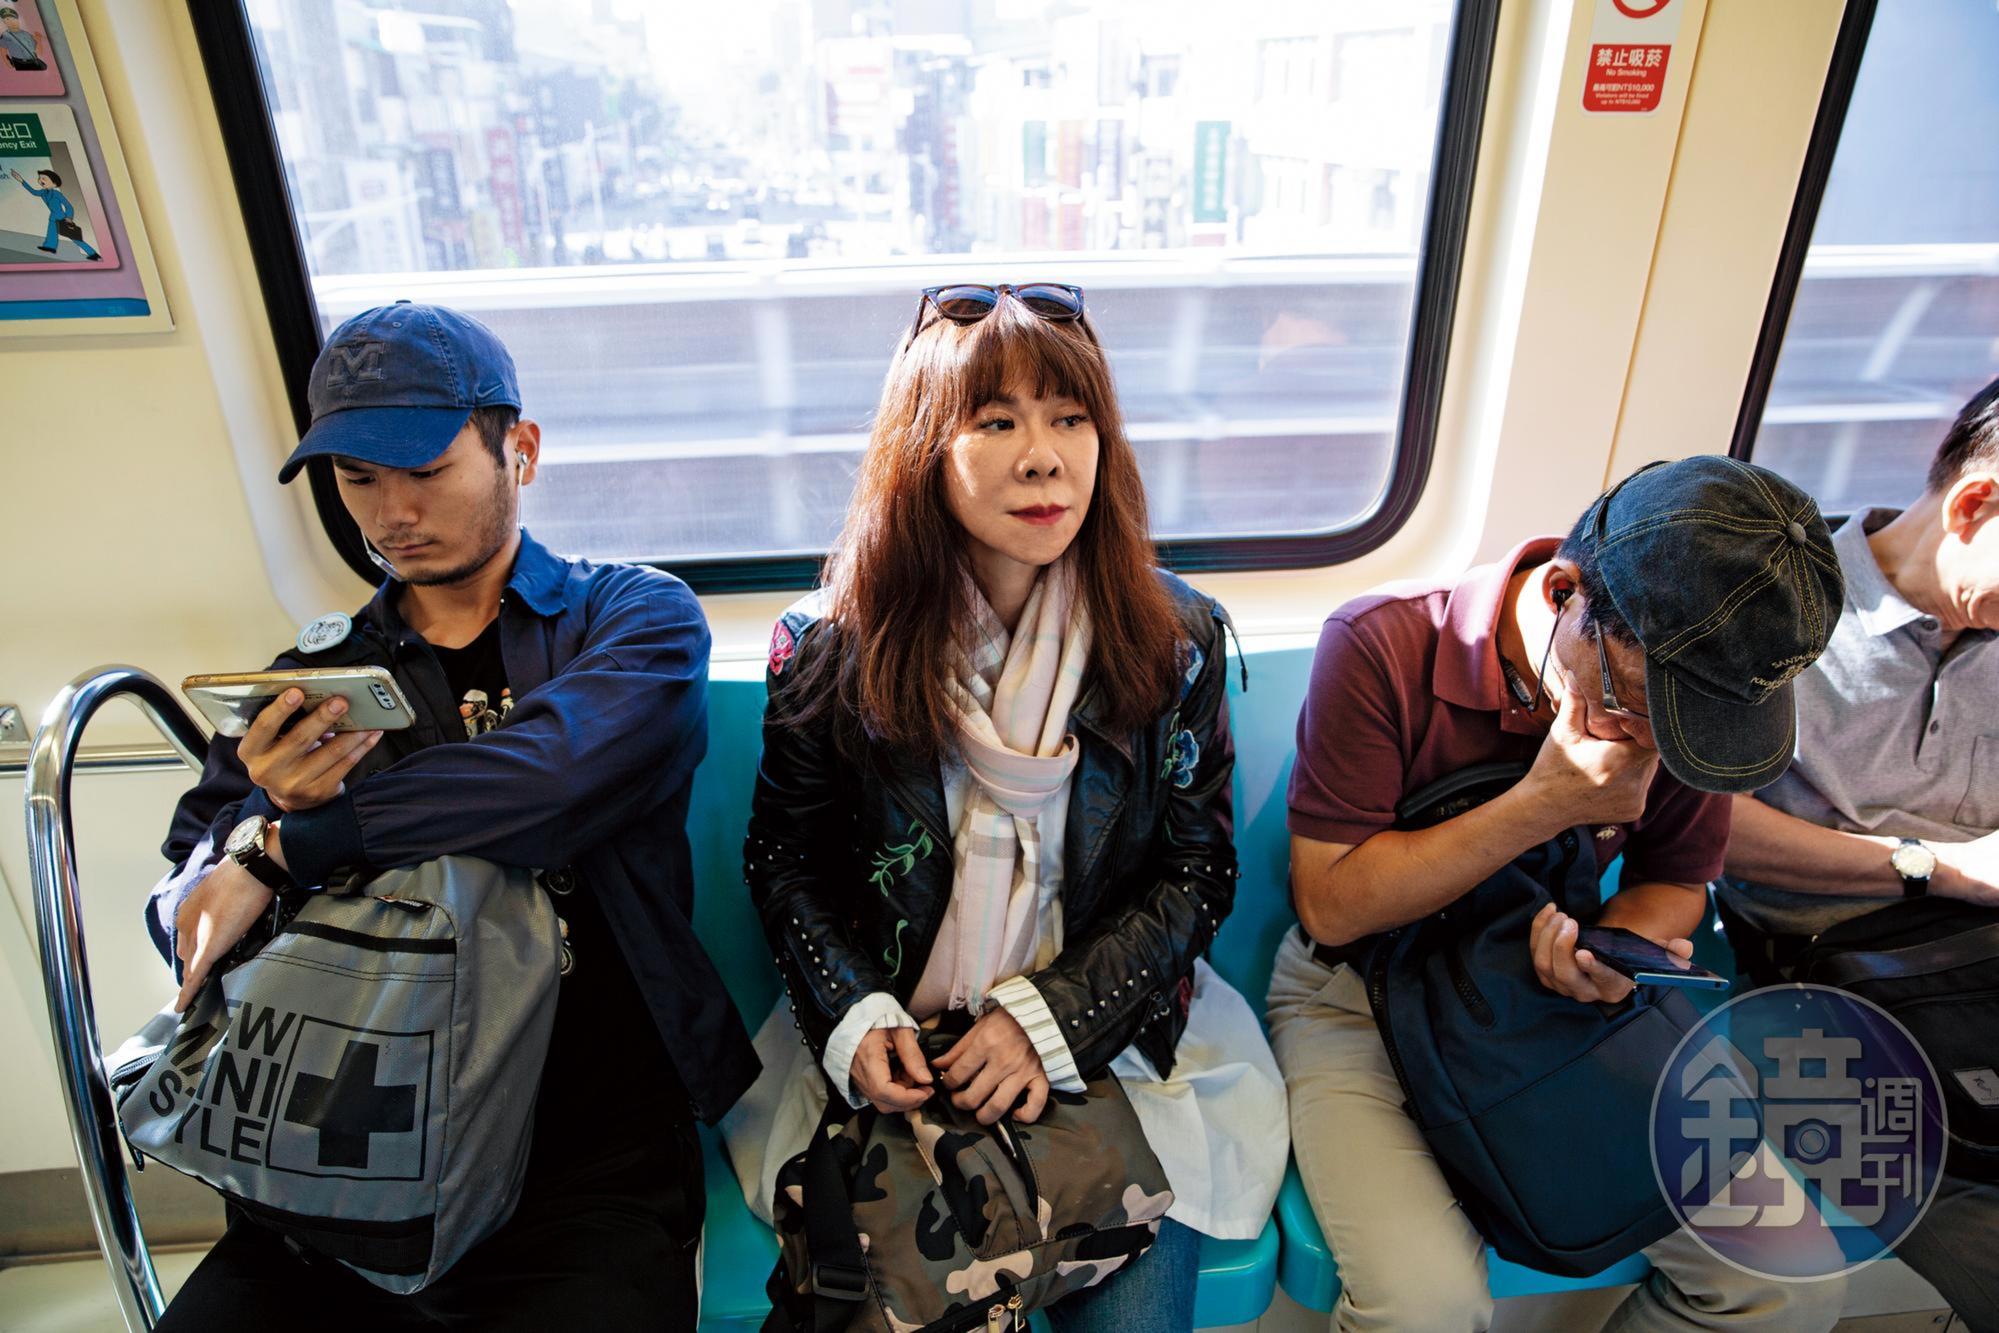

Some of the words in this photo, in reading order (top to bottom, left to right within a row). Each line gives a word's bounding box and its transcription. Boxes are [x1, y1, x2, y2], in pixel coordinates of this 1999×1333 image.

[1617, 68, 1648, 77] Smoking
[0, 122, 32, 139] 出口
[19, 140, 37, 149] Exit
[327, 341, 387, 389] M
